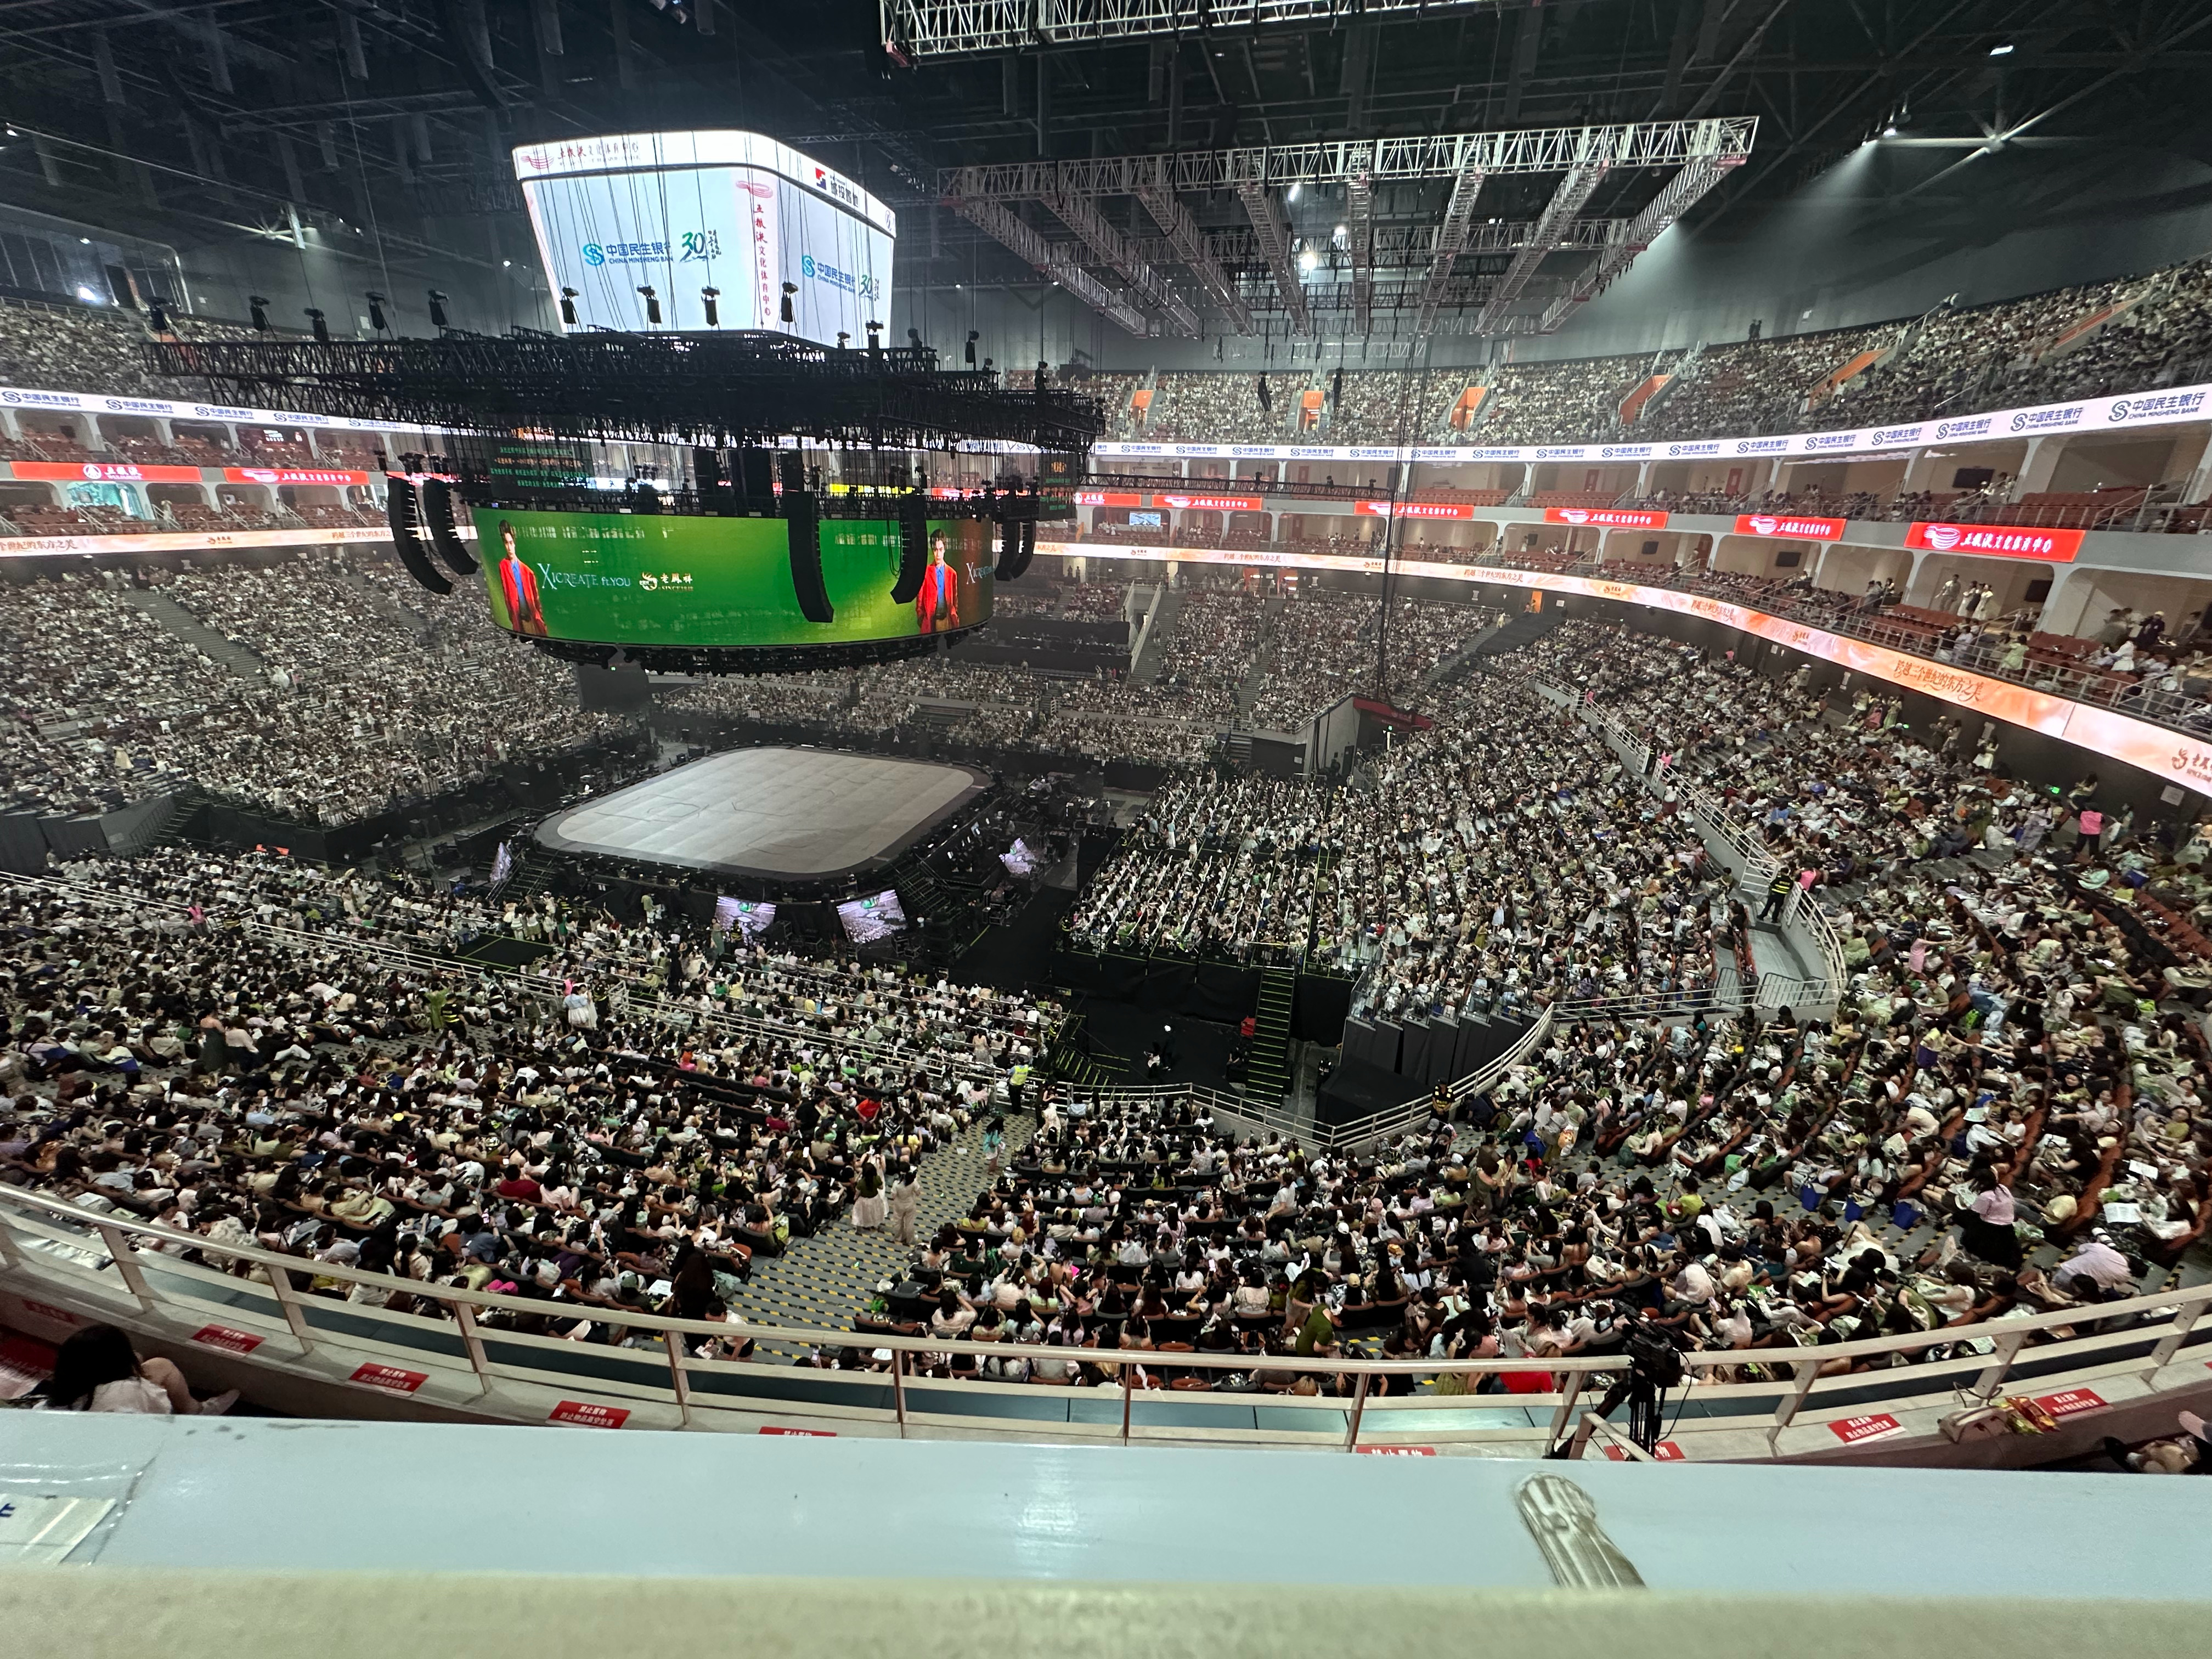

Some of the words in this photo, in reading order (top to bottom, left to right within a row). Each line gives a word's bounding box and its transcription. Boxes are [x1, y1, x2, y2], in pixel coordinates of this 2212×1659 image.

[609, 256, 628, 264] CHINA
[2132, 392, 2207, 411] 中国民生银行
[2028, 407, 2084, 422] 中国民生银行
[1893, 659, 1984, 702] 跨越三个世纪的东方之美
